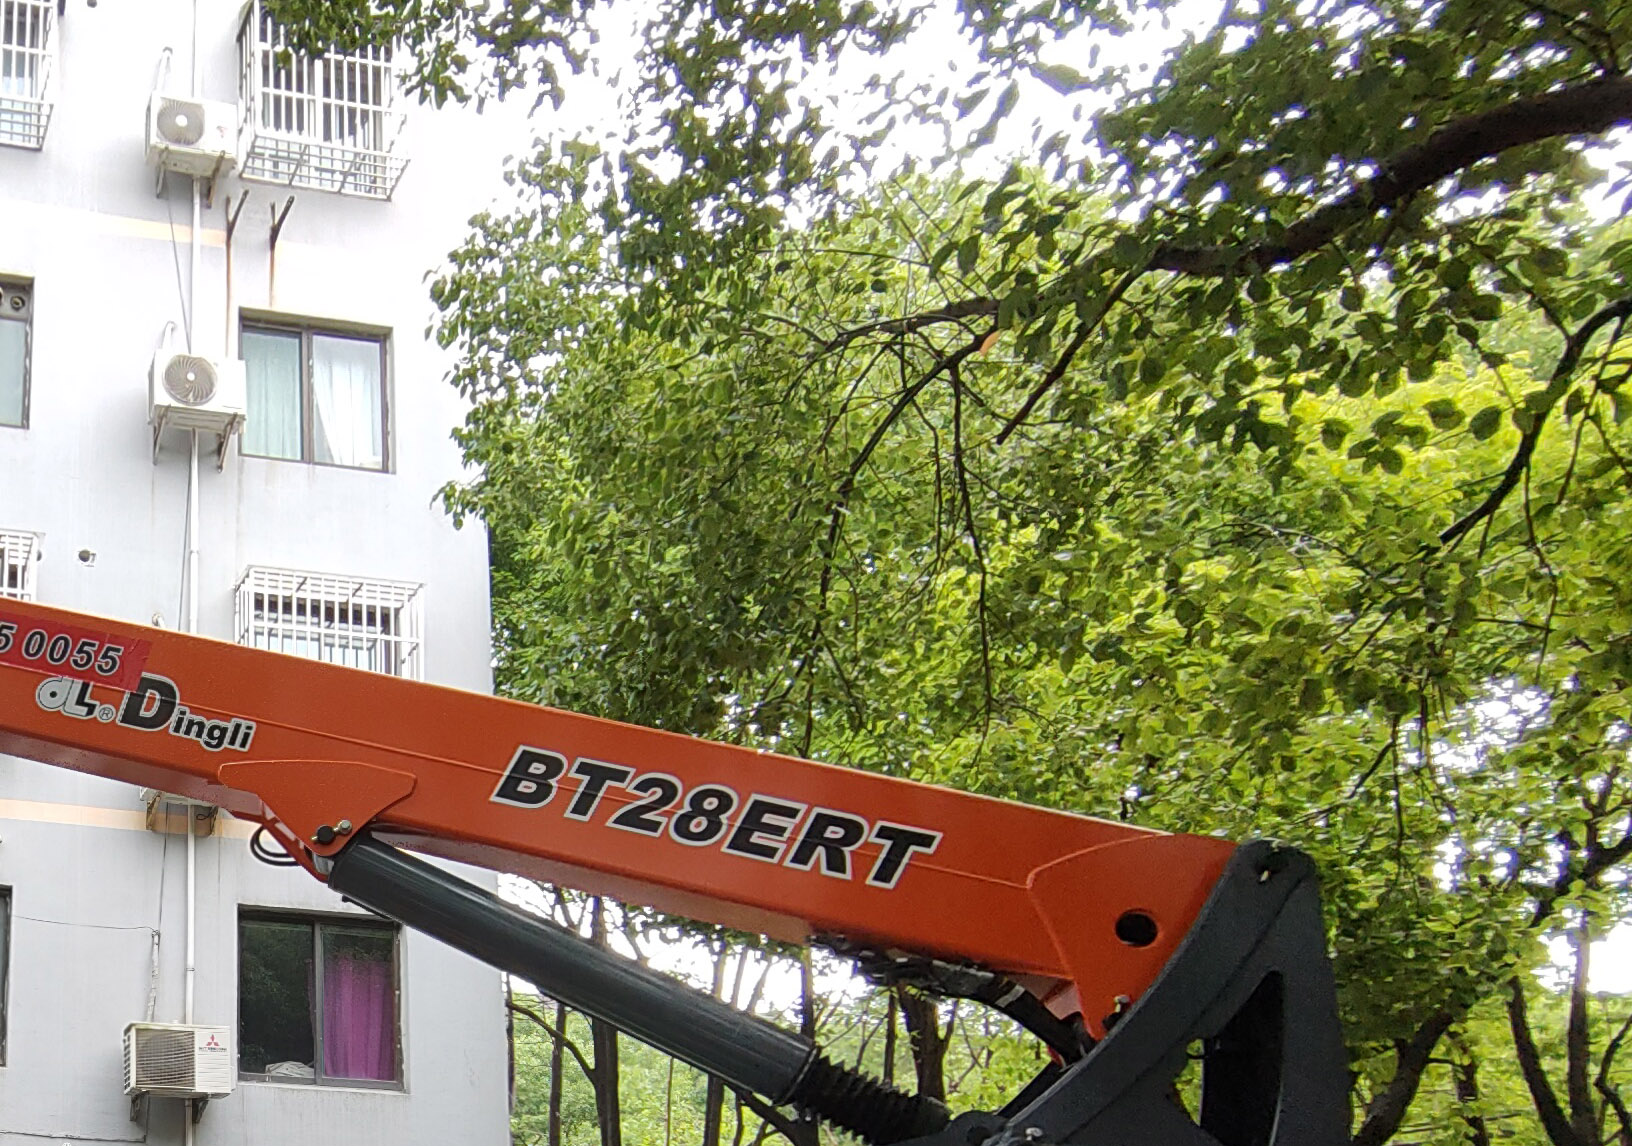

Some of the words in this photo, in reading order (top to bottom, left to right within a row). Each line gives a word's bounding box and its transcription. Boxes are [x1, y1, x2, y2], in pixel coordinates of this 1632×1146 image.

[23, 630, 124, 676] 0055
[117, 671, 257, 752] Dingli
[489, 744, 943, 889] BT28ERT
